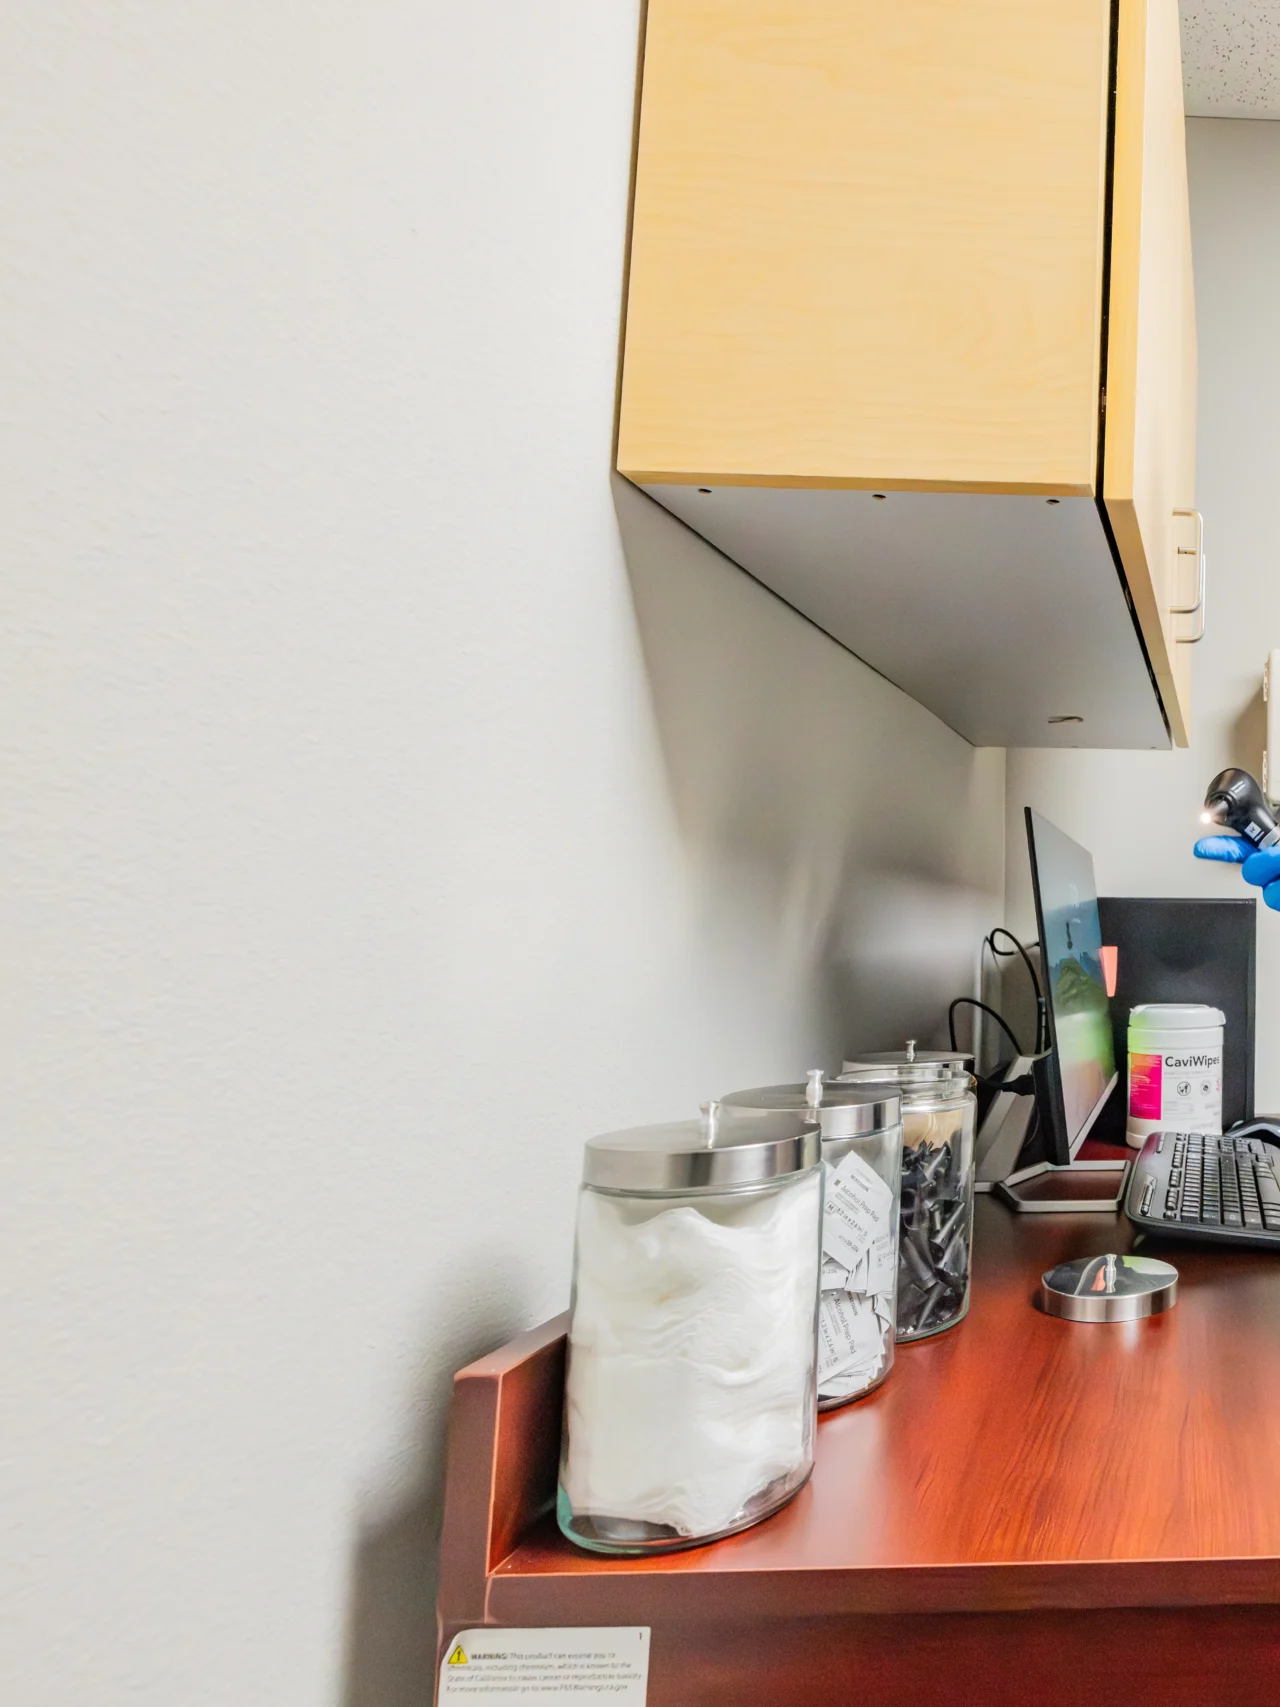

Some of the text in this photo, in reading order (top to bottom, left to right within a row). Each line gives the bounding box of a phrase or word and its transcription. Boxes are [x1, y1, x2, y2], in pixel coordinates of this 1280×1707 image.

[1165, 1055, 1220, 1068] CaviWipes
[841, 1185, 861, 1204] Alcohol
[860, 1200, 871, 1214] Prep
[870, 1211, 880, 1222] Pad
[834, 1298, 846, 1325] Alcohol
[843, 1322, 852, 1341] Prep
[848, 1340, 857, 1354] Pad
